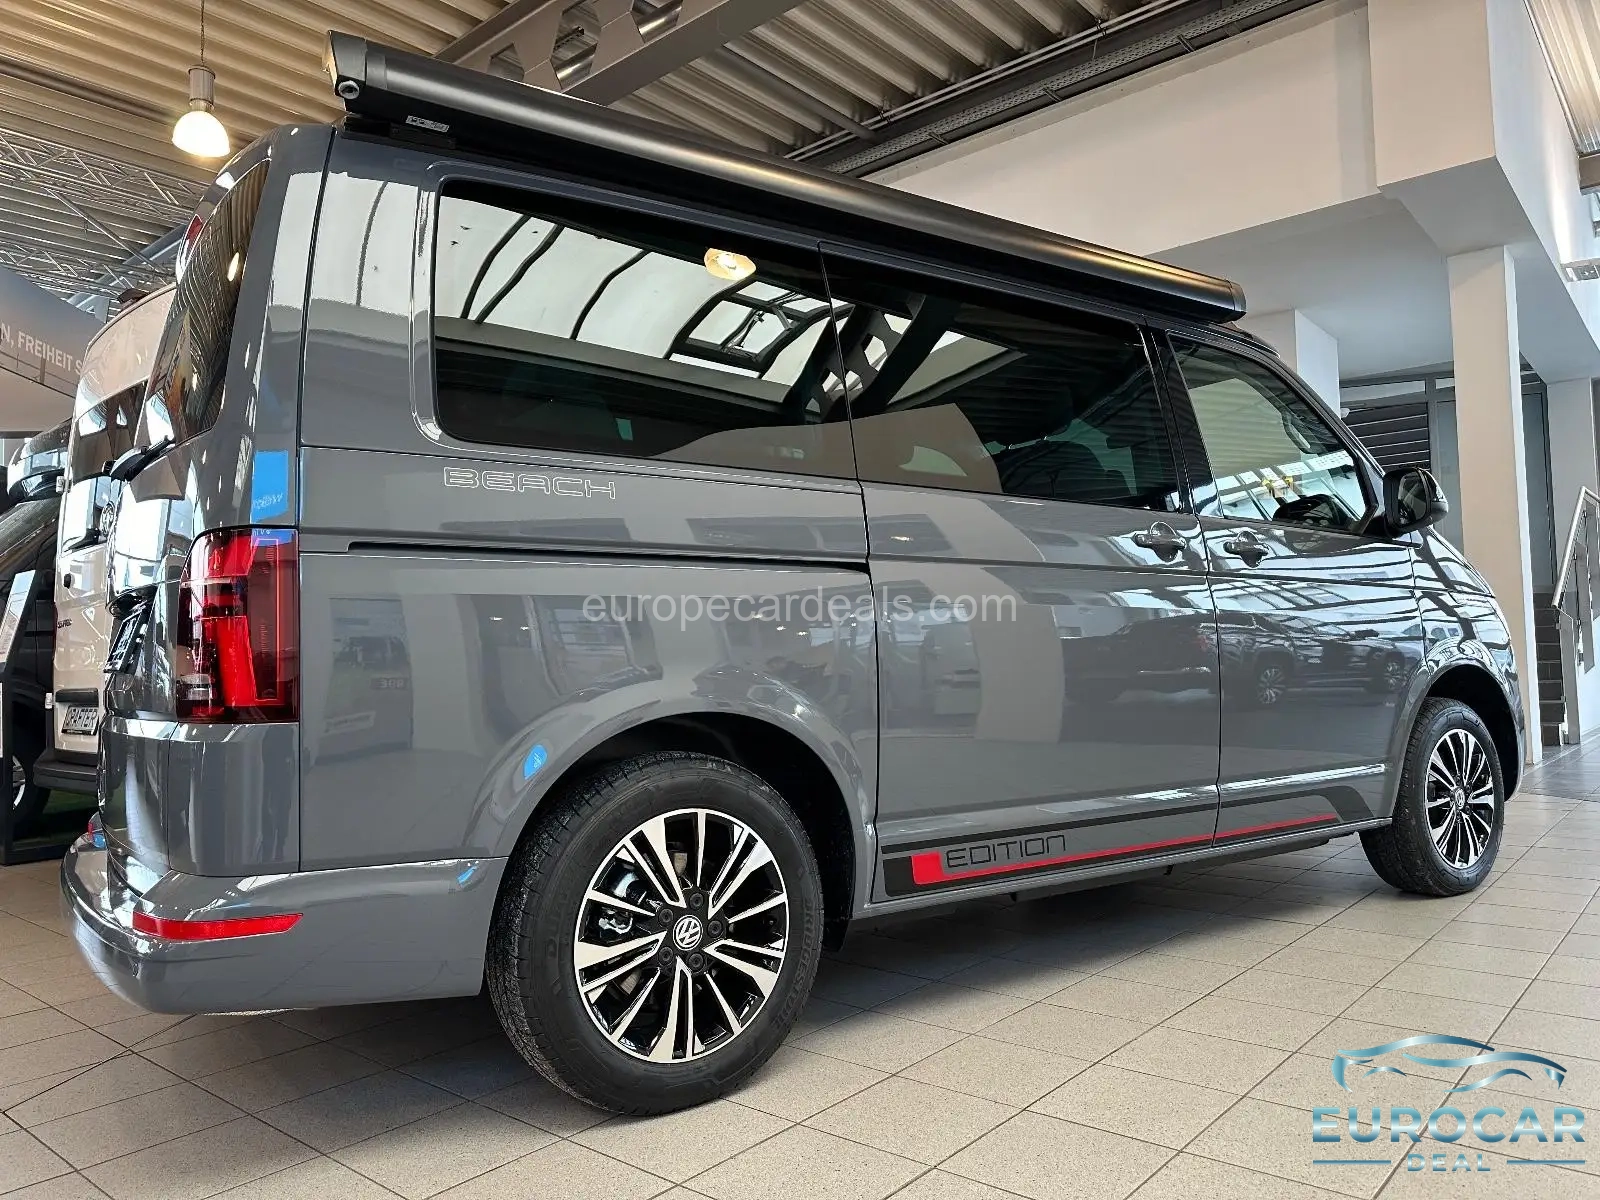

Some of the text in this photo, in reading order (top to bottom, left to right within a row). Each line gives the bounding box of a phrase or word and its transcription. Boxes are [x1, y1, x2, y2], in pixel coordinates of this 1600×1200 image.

[17, 330, 73, 372] FREIHEIT
[443, 466, 616, 500] BEACH
[946, 835, 1066, 868] EDITION
